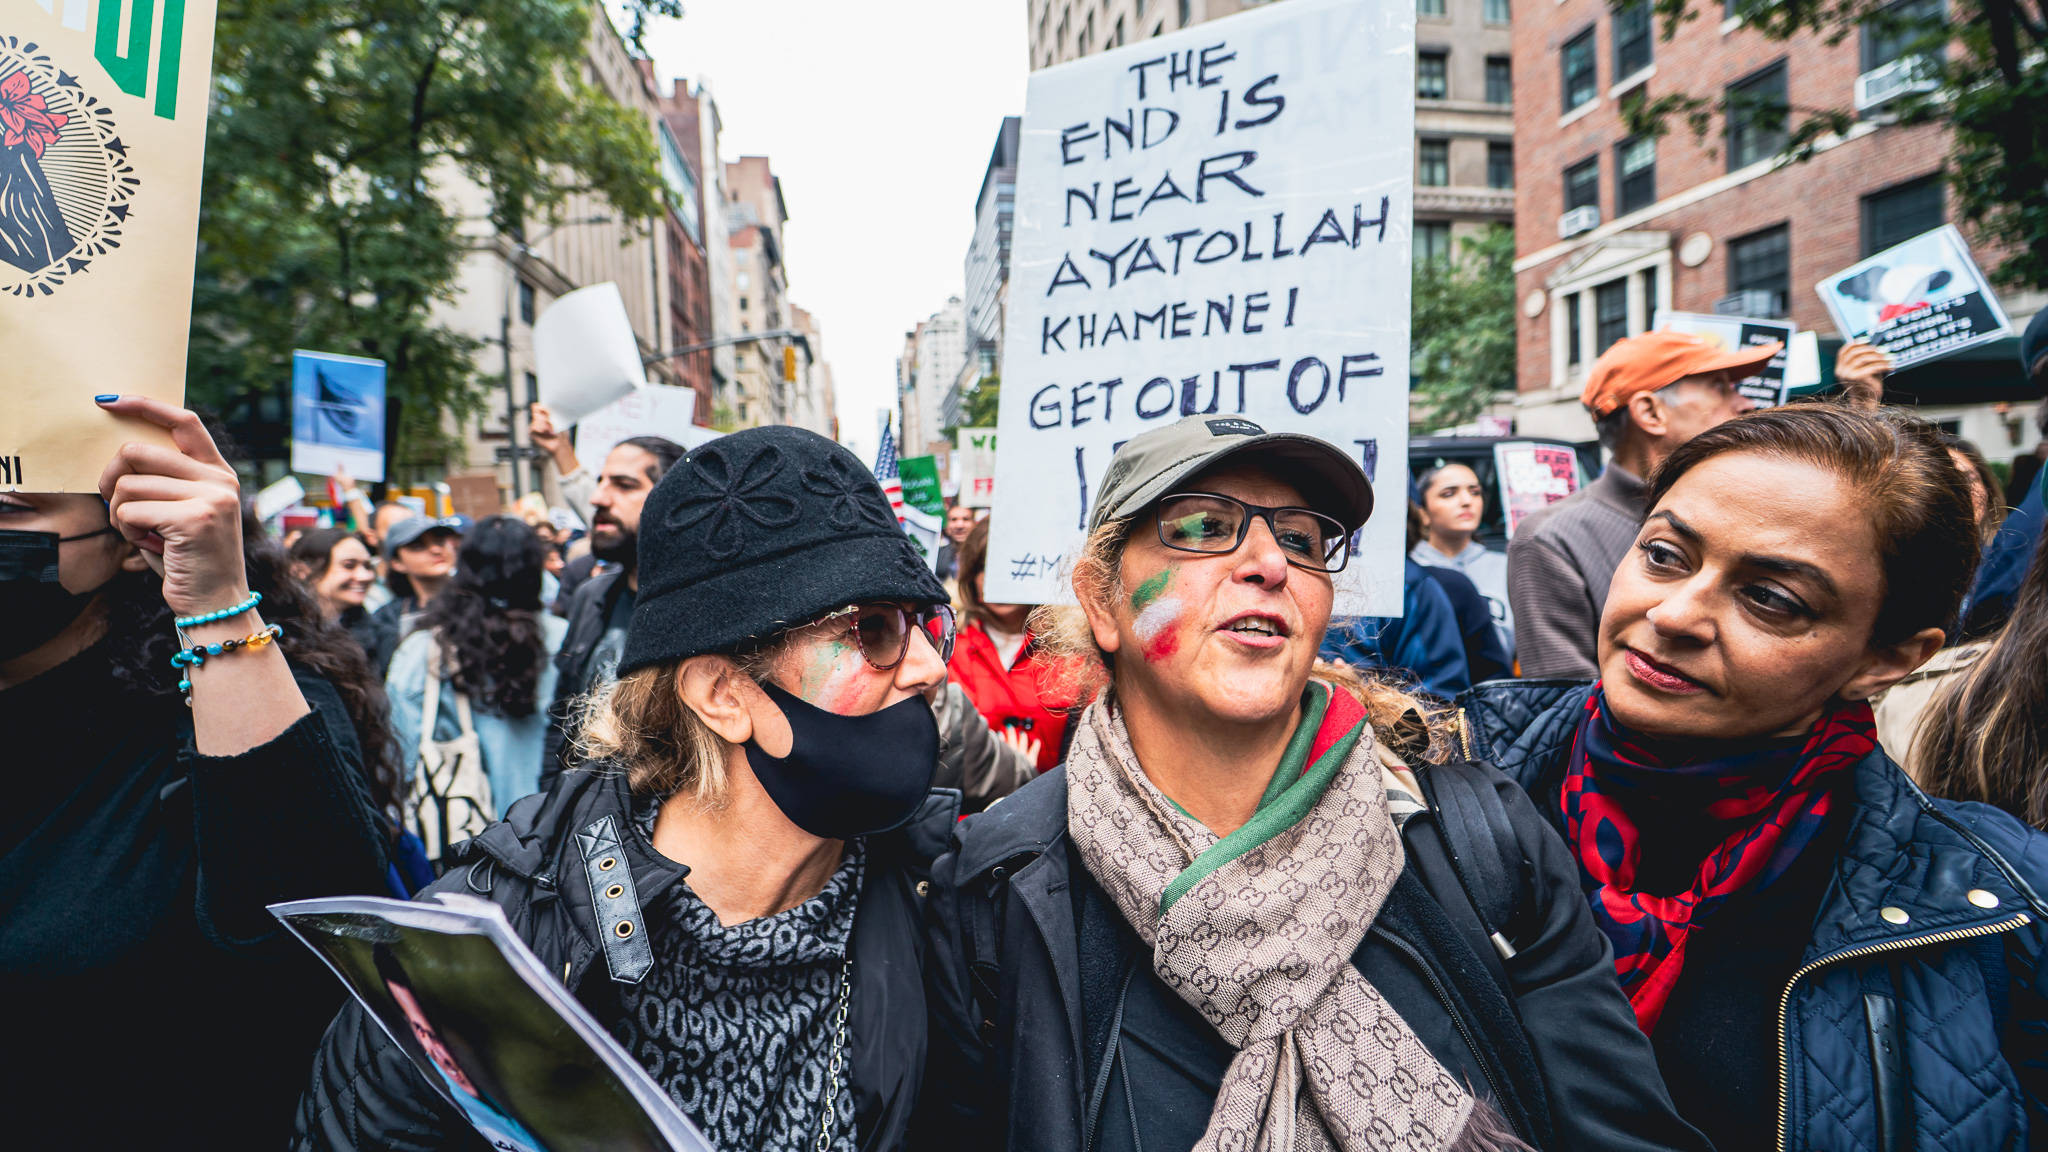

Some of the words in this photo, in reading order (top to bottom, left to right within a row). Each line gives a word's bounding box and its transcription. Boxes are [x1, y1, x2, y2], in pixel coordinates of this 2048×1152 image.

[1128, 42, 1237, 101] THE
[1060, 107, 1181, 167] END
[1216, 74, 1286, 136] IS
[1063, 150, 1265, 227] NEAR
[1046, 195, 1390, 297] AYATOLLAH
[1041, 287, 1300, 355] KHAMENEI
[1029, 377, 1124, 430] GET
[1135, 358, 1281, 421] OUT
[1285, 352, 1384, 417] OF
